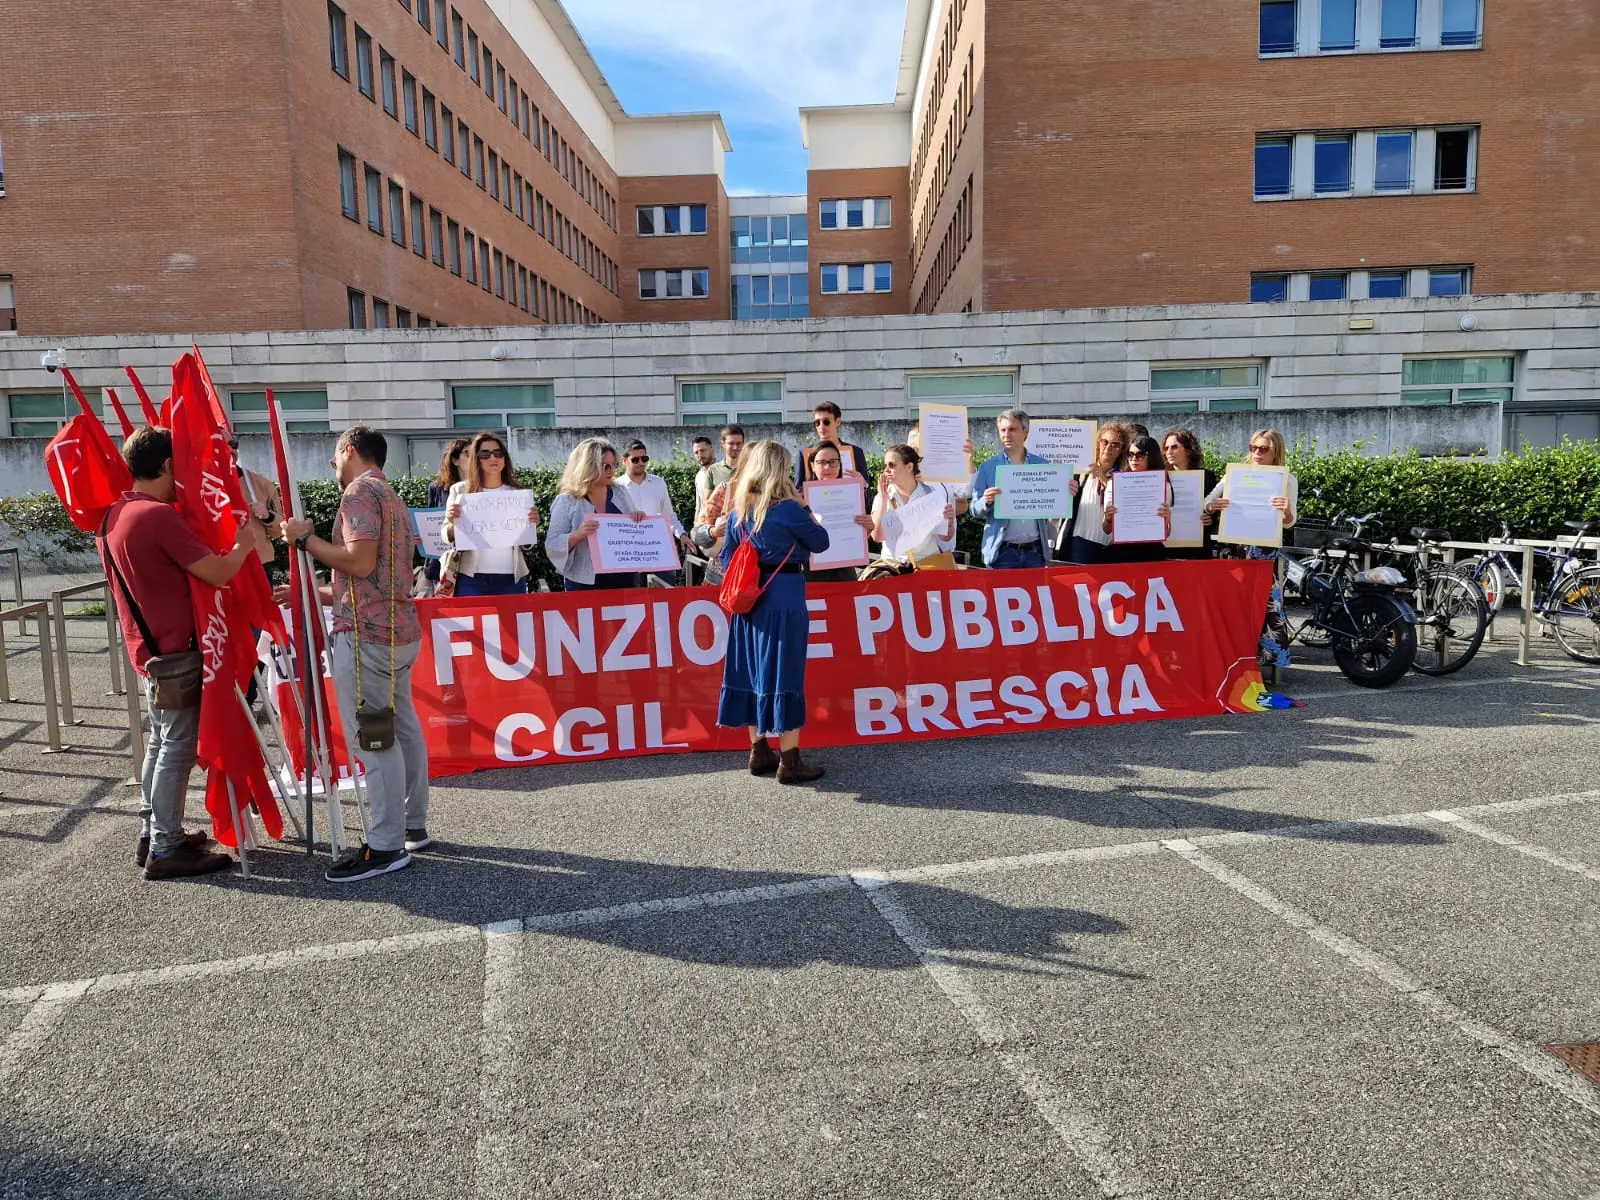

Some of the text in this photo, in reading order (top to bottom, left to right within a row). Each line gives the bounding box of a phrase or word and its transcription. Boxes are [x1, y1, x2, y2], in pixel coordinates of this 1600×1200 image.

[431, 576, 1184, 686] FUNZIOE PUBBLICA
[494, 664, 1167, 762] CGIL BRESCIA
